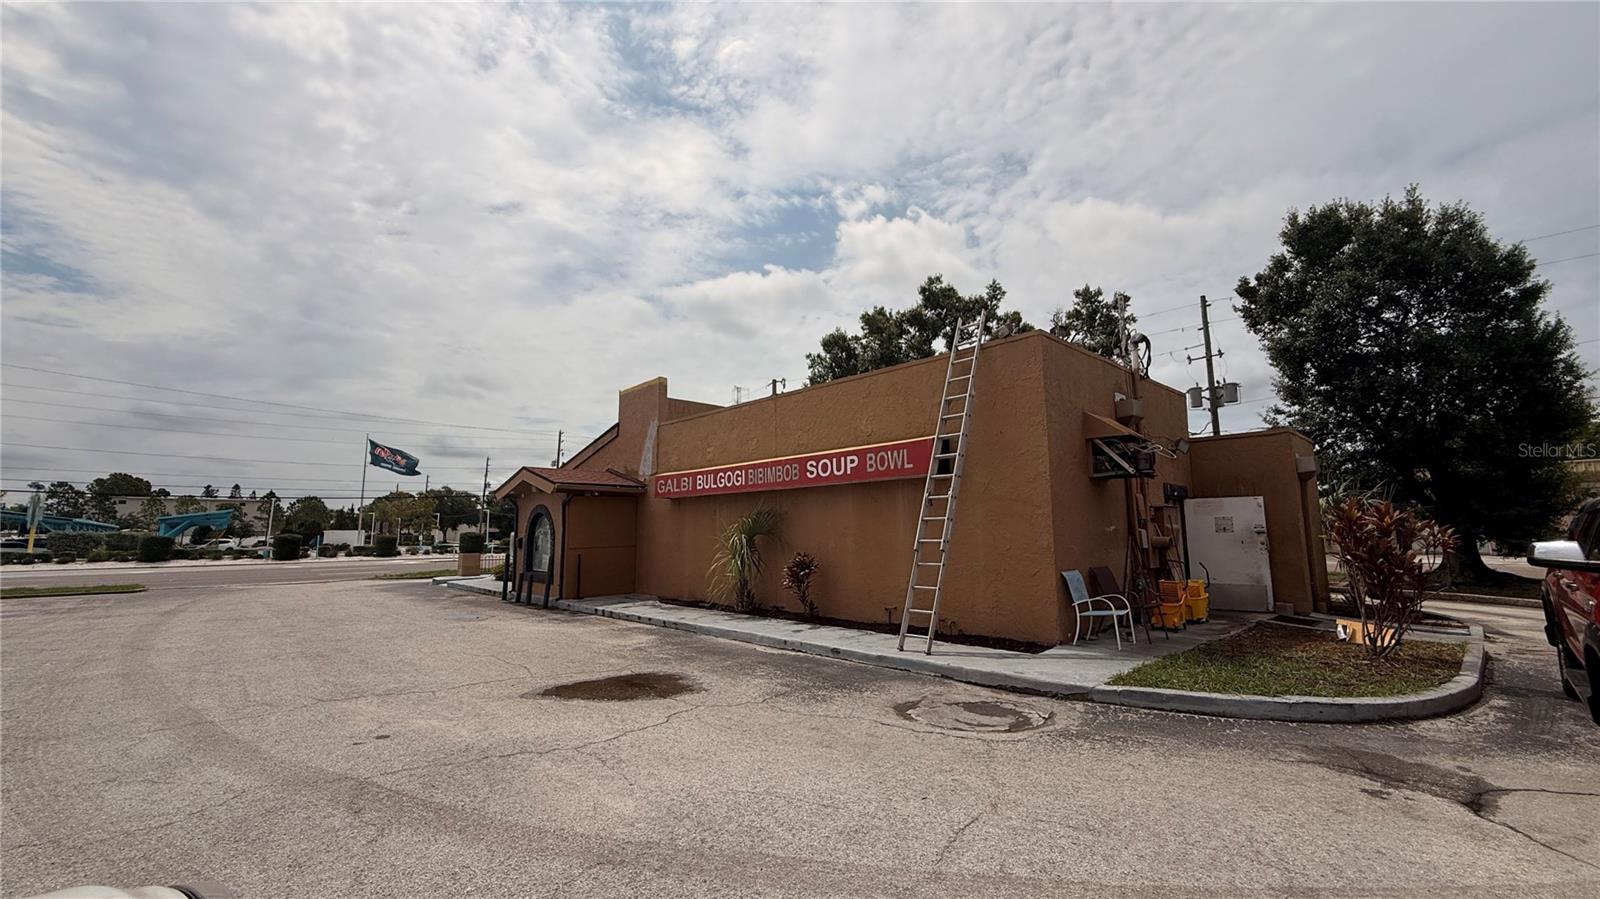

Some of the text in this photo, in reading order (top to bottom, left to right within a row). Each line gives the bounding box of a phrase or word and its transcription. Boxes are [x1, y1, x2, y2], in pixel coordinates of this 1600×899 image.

[656, 448, 914, 494] GALBI BULGOGI BIBIMBOB SOUP BOWL
